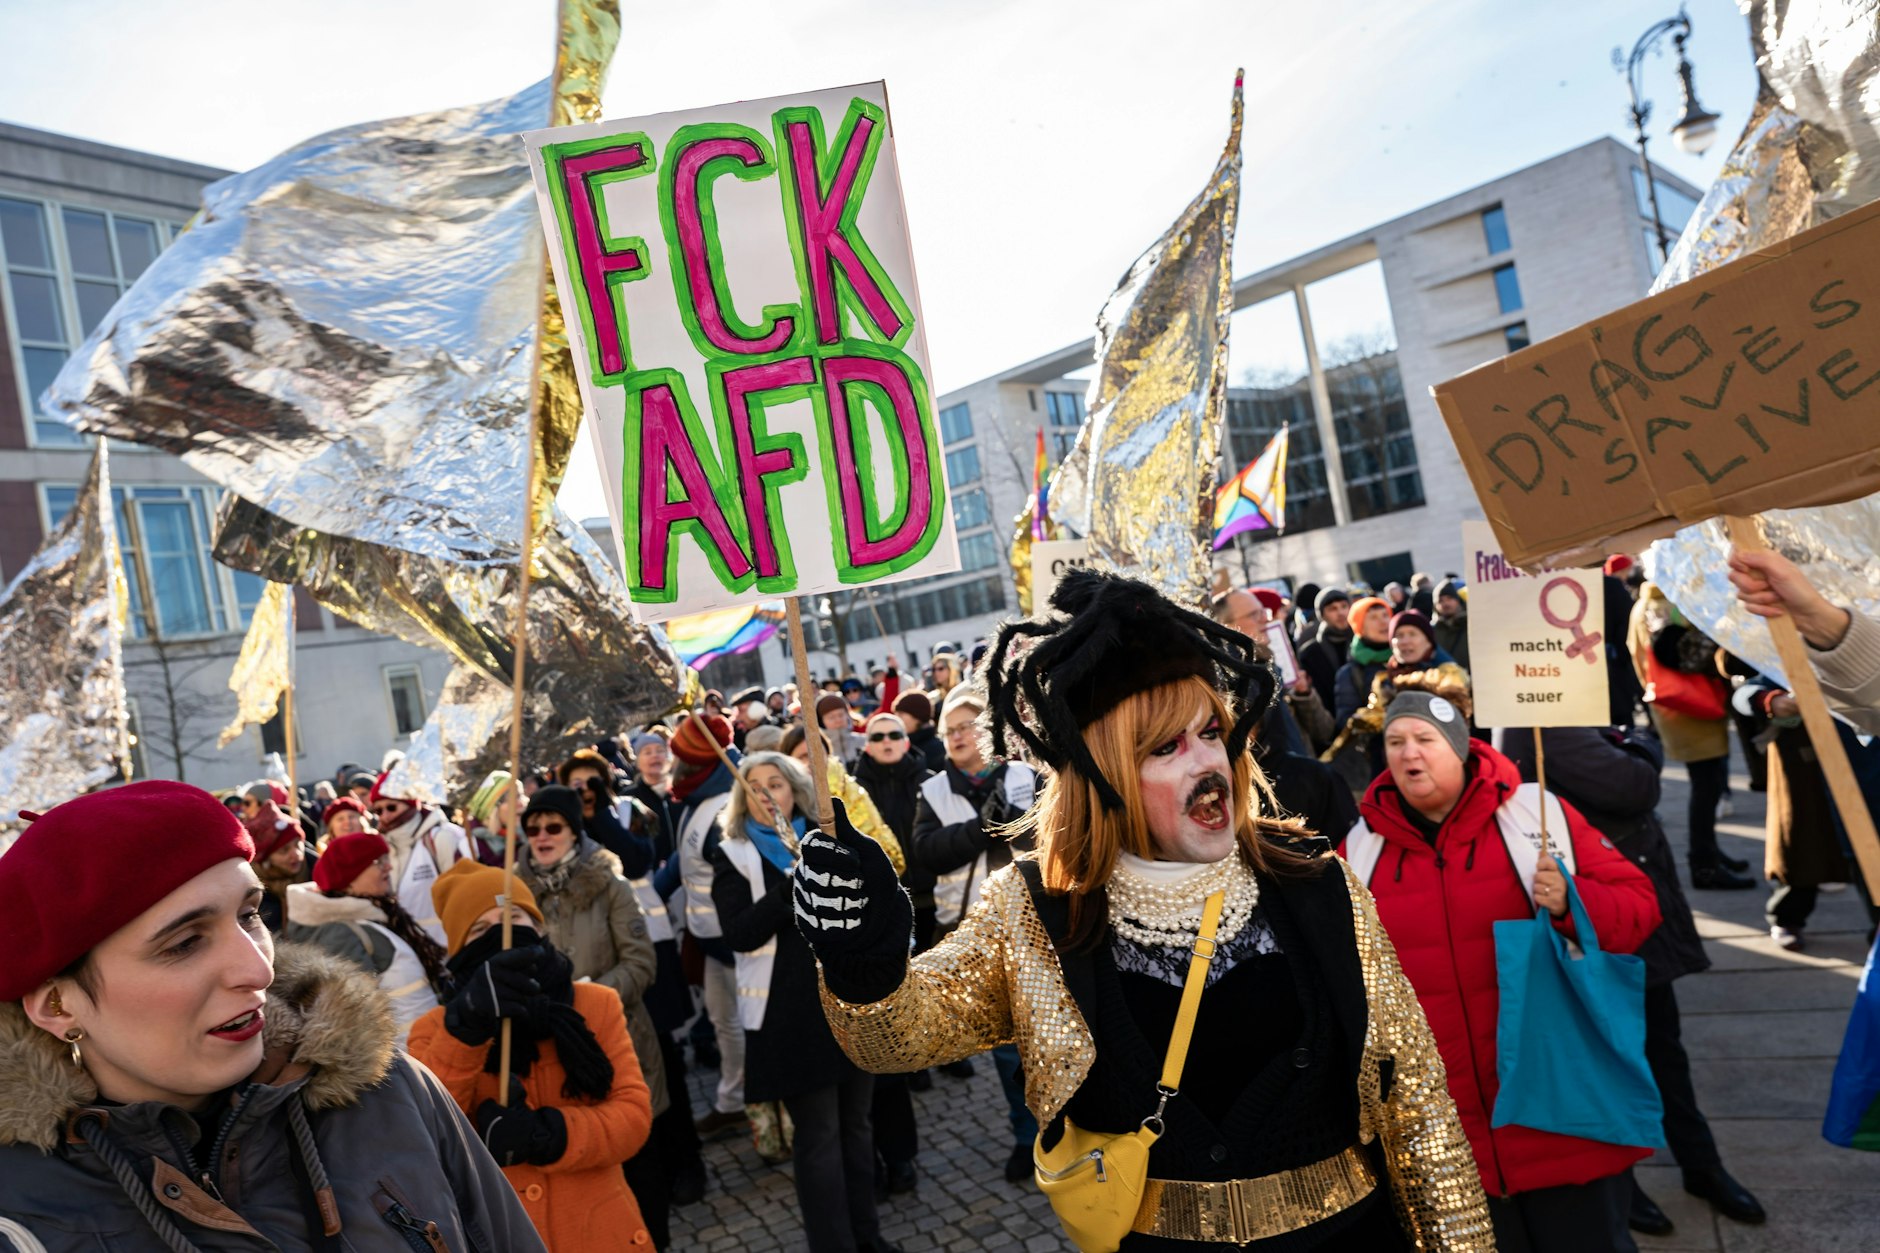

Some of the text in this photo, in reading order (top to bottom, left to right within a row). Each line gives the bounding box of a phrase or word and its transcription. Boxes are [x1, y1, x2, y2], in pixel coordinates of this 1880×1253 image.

[543, 97, 914, 386] FCK
[624, 338, 944, 602] AFD
[1486, 312, 1714, 496] DRAG
[1603, 278, 1863, 485] SAVES
[1509, 637, 1563, 652] macht
[1515, 663, 1561, 677] Nazis
[1516, 692, 1563, 703] sauer
